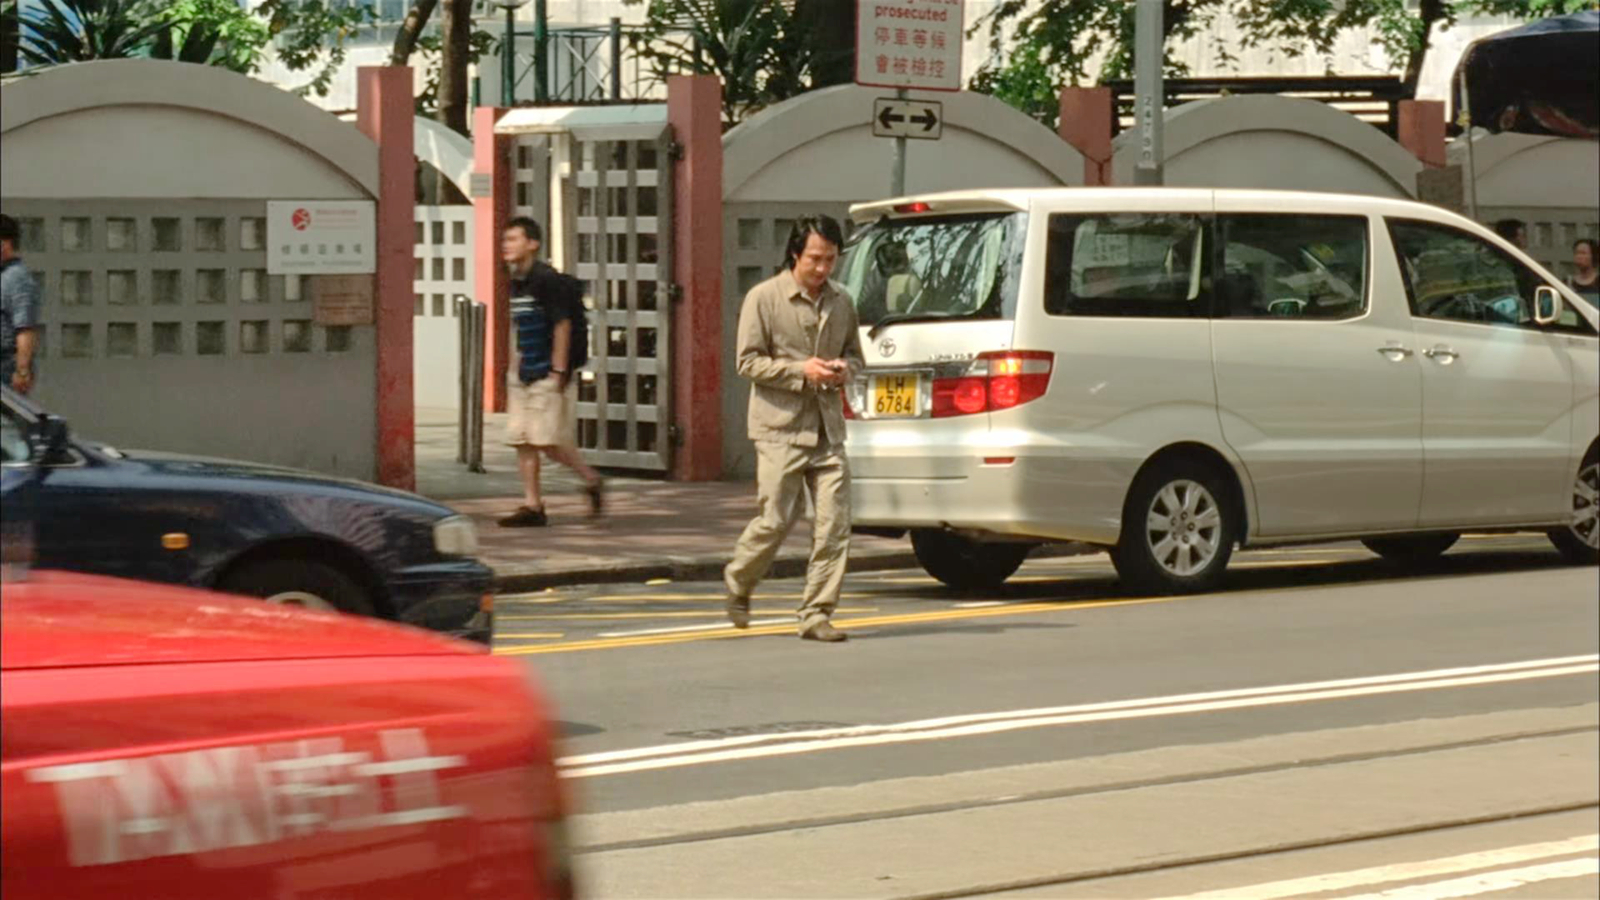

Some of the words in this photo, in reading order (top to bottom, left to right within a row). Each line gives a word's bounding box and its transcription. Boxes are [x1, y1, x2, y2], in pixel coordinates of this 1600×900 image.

[875, 5, 948, 21] prosecuted
[874, 26, 946, 49] 停車等候
[876, 54, 945, 78] 會被檢控
[886, 376, 905, 394] LH
[876, 396, 911, 413] 6784
